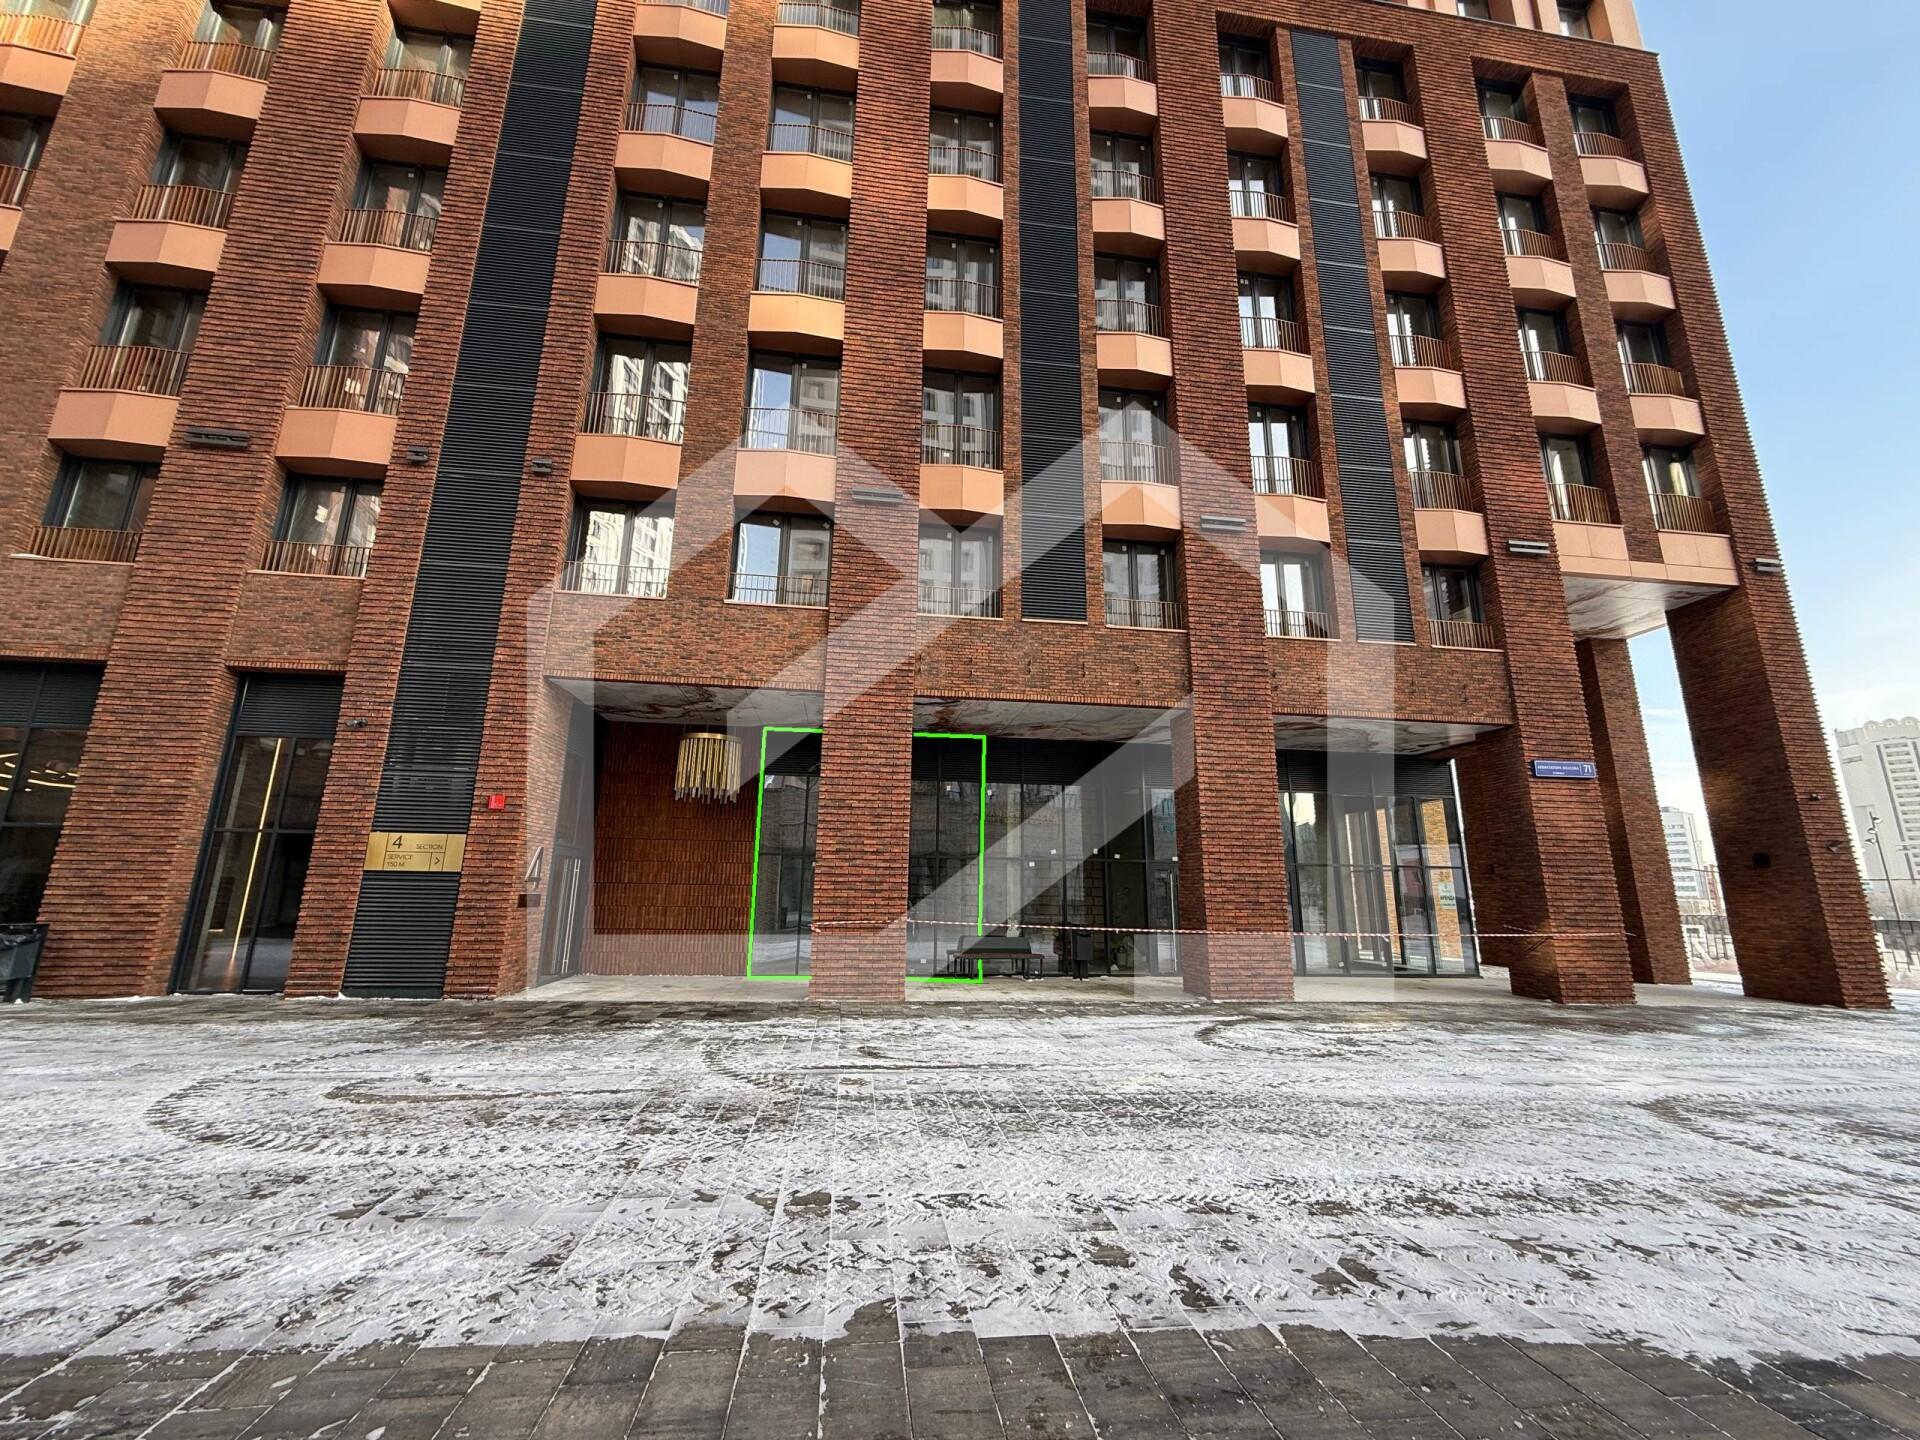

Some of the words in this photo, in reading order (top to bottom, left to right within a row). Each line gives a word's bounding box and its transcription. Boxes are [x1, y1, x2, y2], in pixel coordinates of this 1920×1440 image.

[1583, 764, 1592, 773] 71
[392, 835, 403, 849] 4
[524, 846, 544, 889] 4
